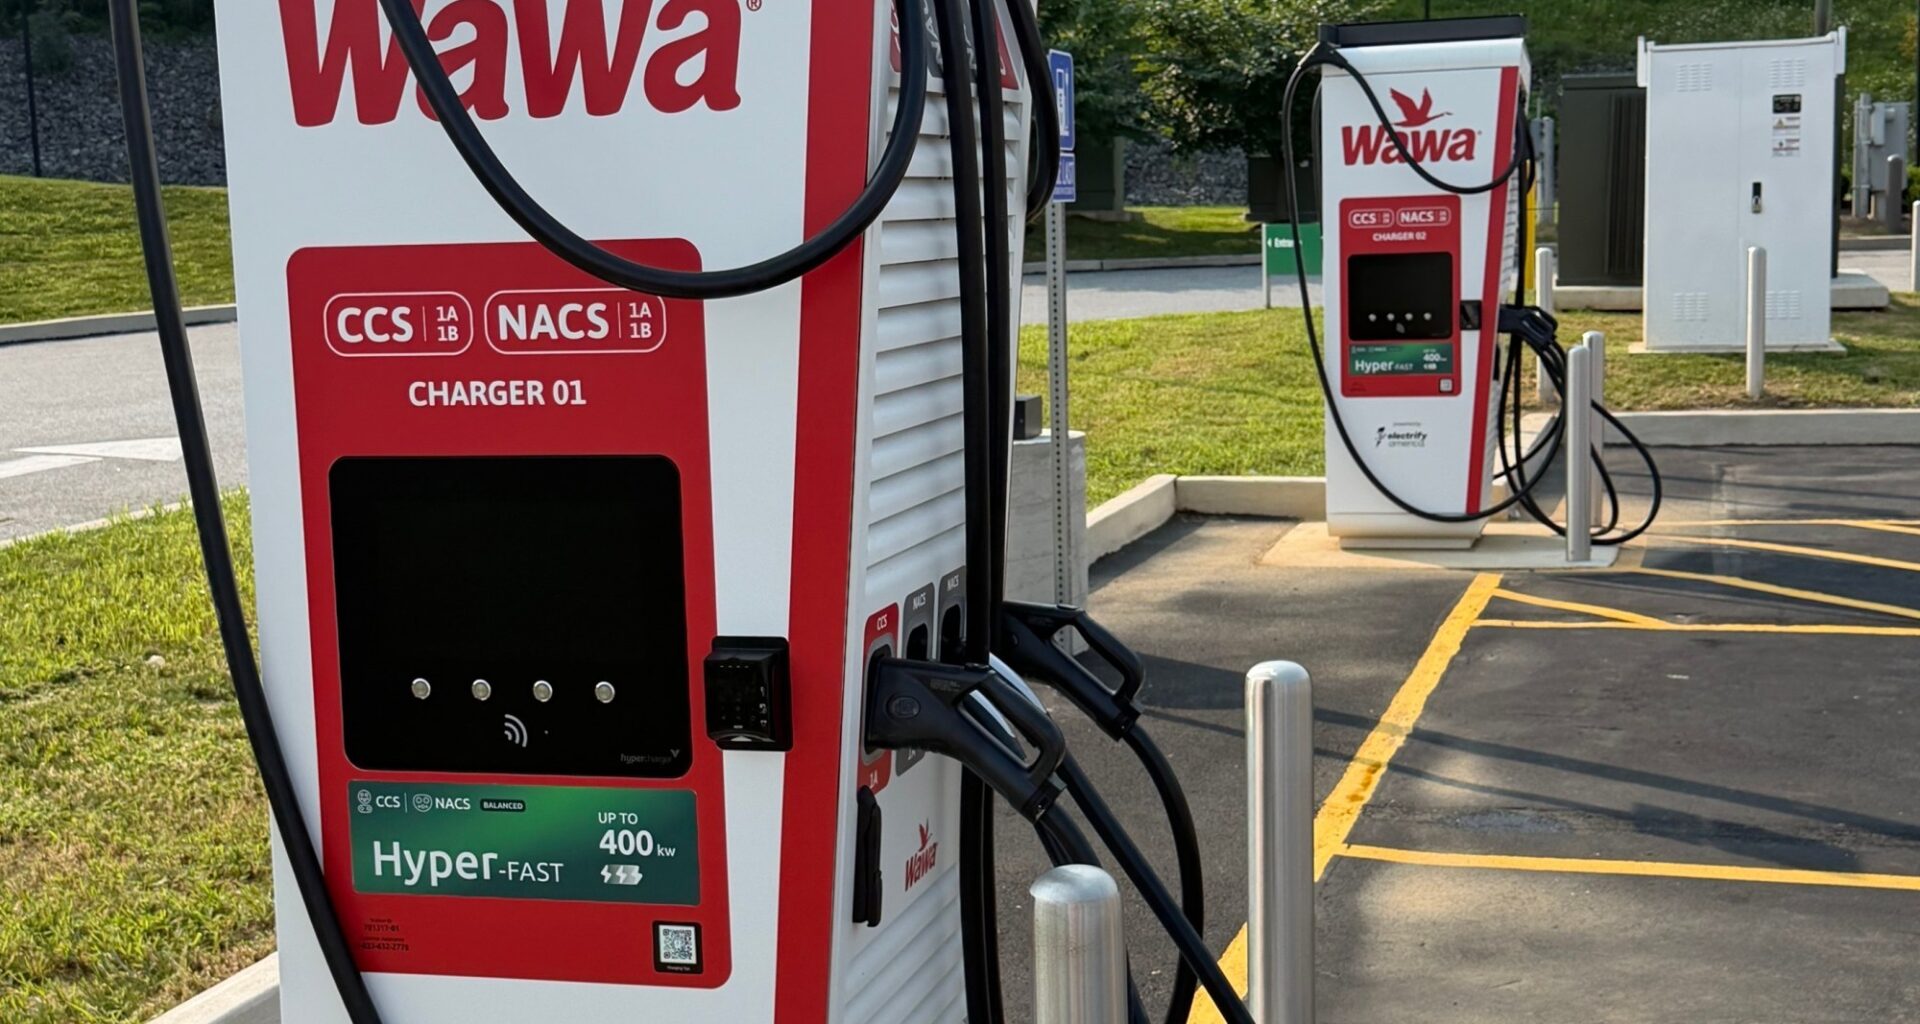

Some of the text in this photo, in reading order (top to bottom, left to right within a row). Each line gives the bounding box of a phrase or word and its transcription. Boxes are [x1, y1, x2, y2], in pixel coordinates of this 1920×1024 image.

[279, 0, 742, 127] Wawa
[1341, 124, 1477, 166] Wawa
[1352, 212, 1377, 225] CCS
[1400, 210, 1435, 223] NACS
[1372, 231, 1427, 242] CHARGER 02
[436, 305, 459, 323] 1A
[629, 301, 652, 320] 1A
[337, 306, 413, 344] CCS
[498, 302, 610, 341] NACS
[629, 321, 652, 339] 1B
[437, 324, 459, 342] 1B
[408, 379, 587, 407] CHARGER 01
[1387, 430, 1428, 441] electrify
[946, 574, 960, 592] NACS
[912, 591, 927, 610] NACS
[876, 613, 888, 631] CCS
[869, 769, 879, 789] 1A
[375, 794, 401, 809] CCS
[434, 796, 471, 811] NACS
[483, 800, 524, 811] BALANCED
[598, 812, 639, 825] UP TO
[599, 829, 676, 857] 400 kw
[904, 841, 939, 893] Wawa
